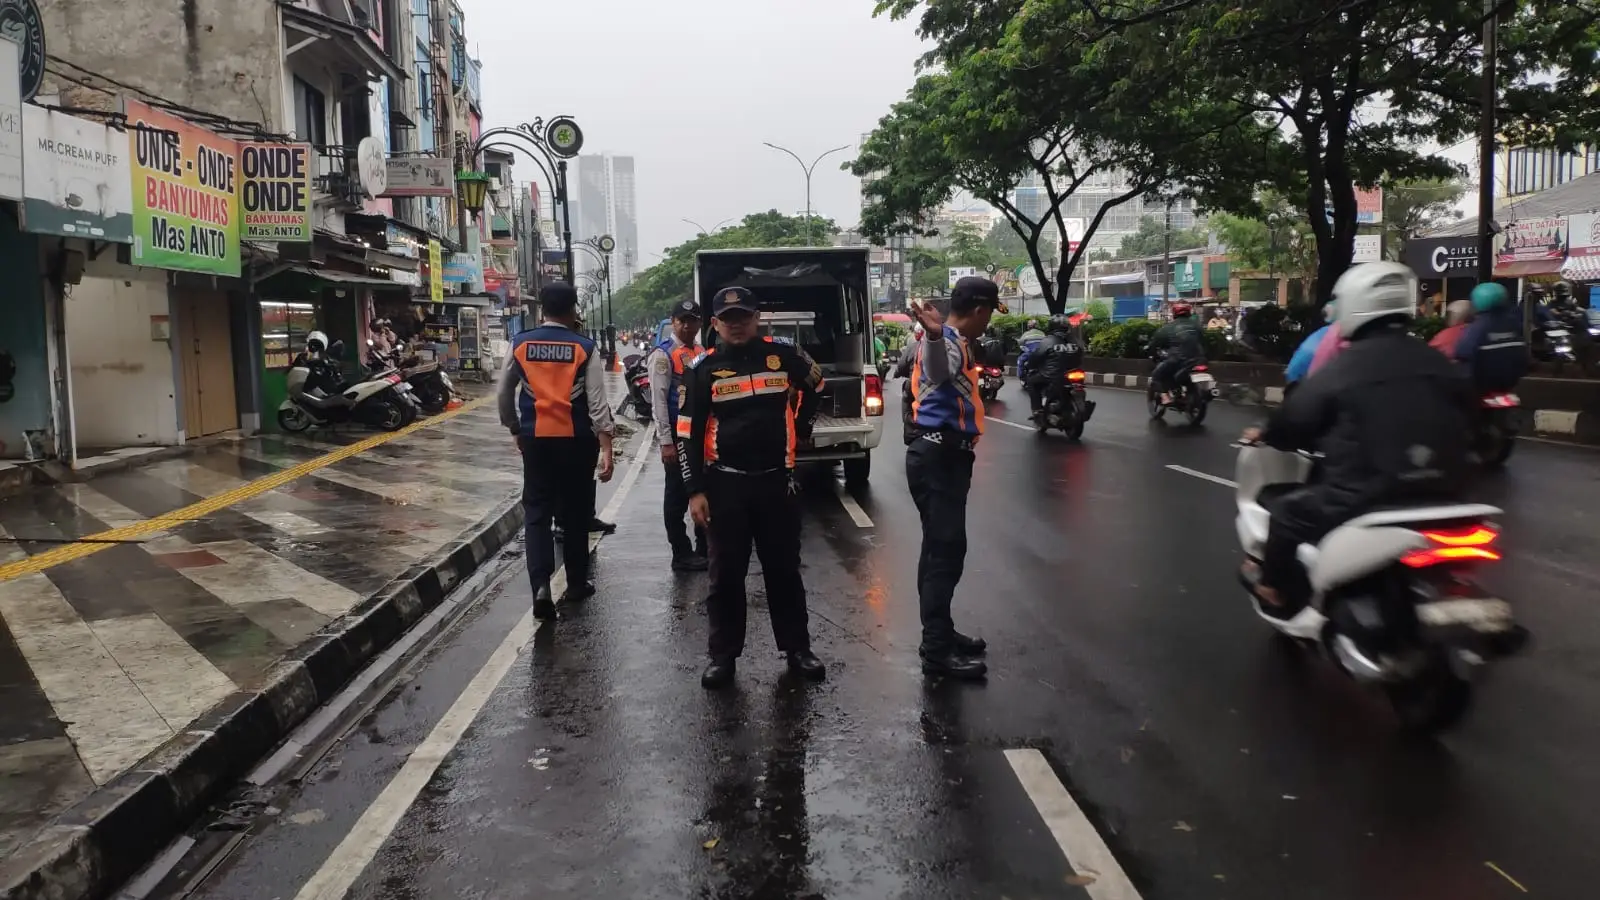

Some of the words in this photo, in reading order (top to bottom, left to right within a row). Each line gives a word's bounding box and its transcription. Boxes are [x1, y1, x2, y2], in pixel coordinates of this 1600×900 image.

[28, 15, 41, 65] PUFF
[38, 137, 93, 161] MR.CREAM
[95, 151, 119, 167] PUFF
[136, 121, 182, 177] ONDE
[197, 145, 234, 194] ONDE
[242, 146, 306, 179] ONDE
[146, 175, 229, 226] BANYUMAS
[243, 181, 306, 212] ONDE
[245, 214, 304, 225] BANYUMAS
[248, 226, 270, 236] Mas
[273, 226, 301, 237] ANTO
[152, 216, 185, 252] Mas
[189, 225, 226, 259] ANTO
[1450, 246, 1479, 255] CIRCL
[1431, 246, 1449, 273] C
[527, 344, 573, 360] DISHUB
